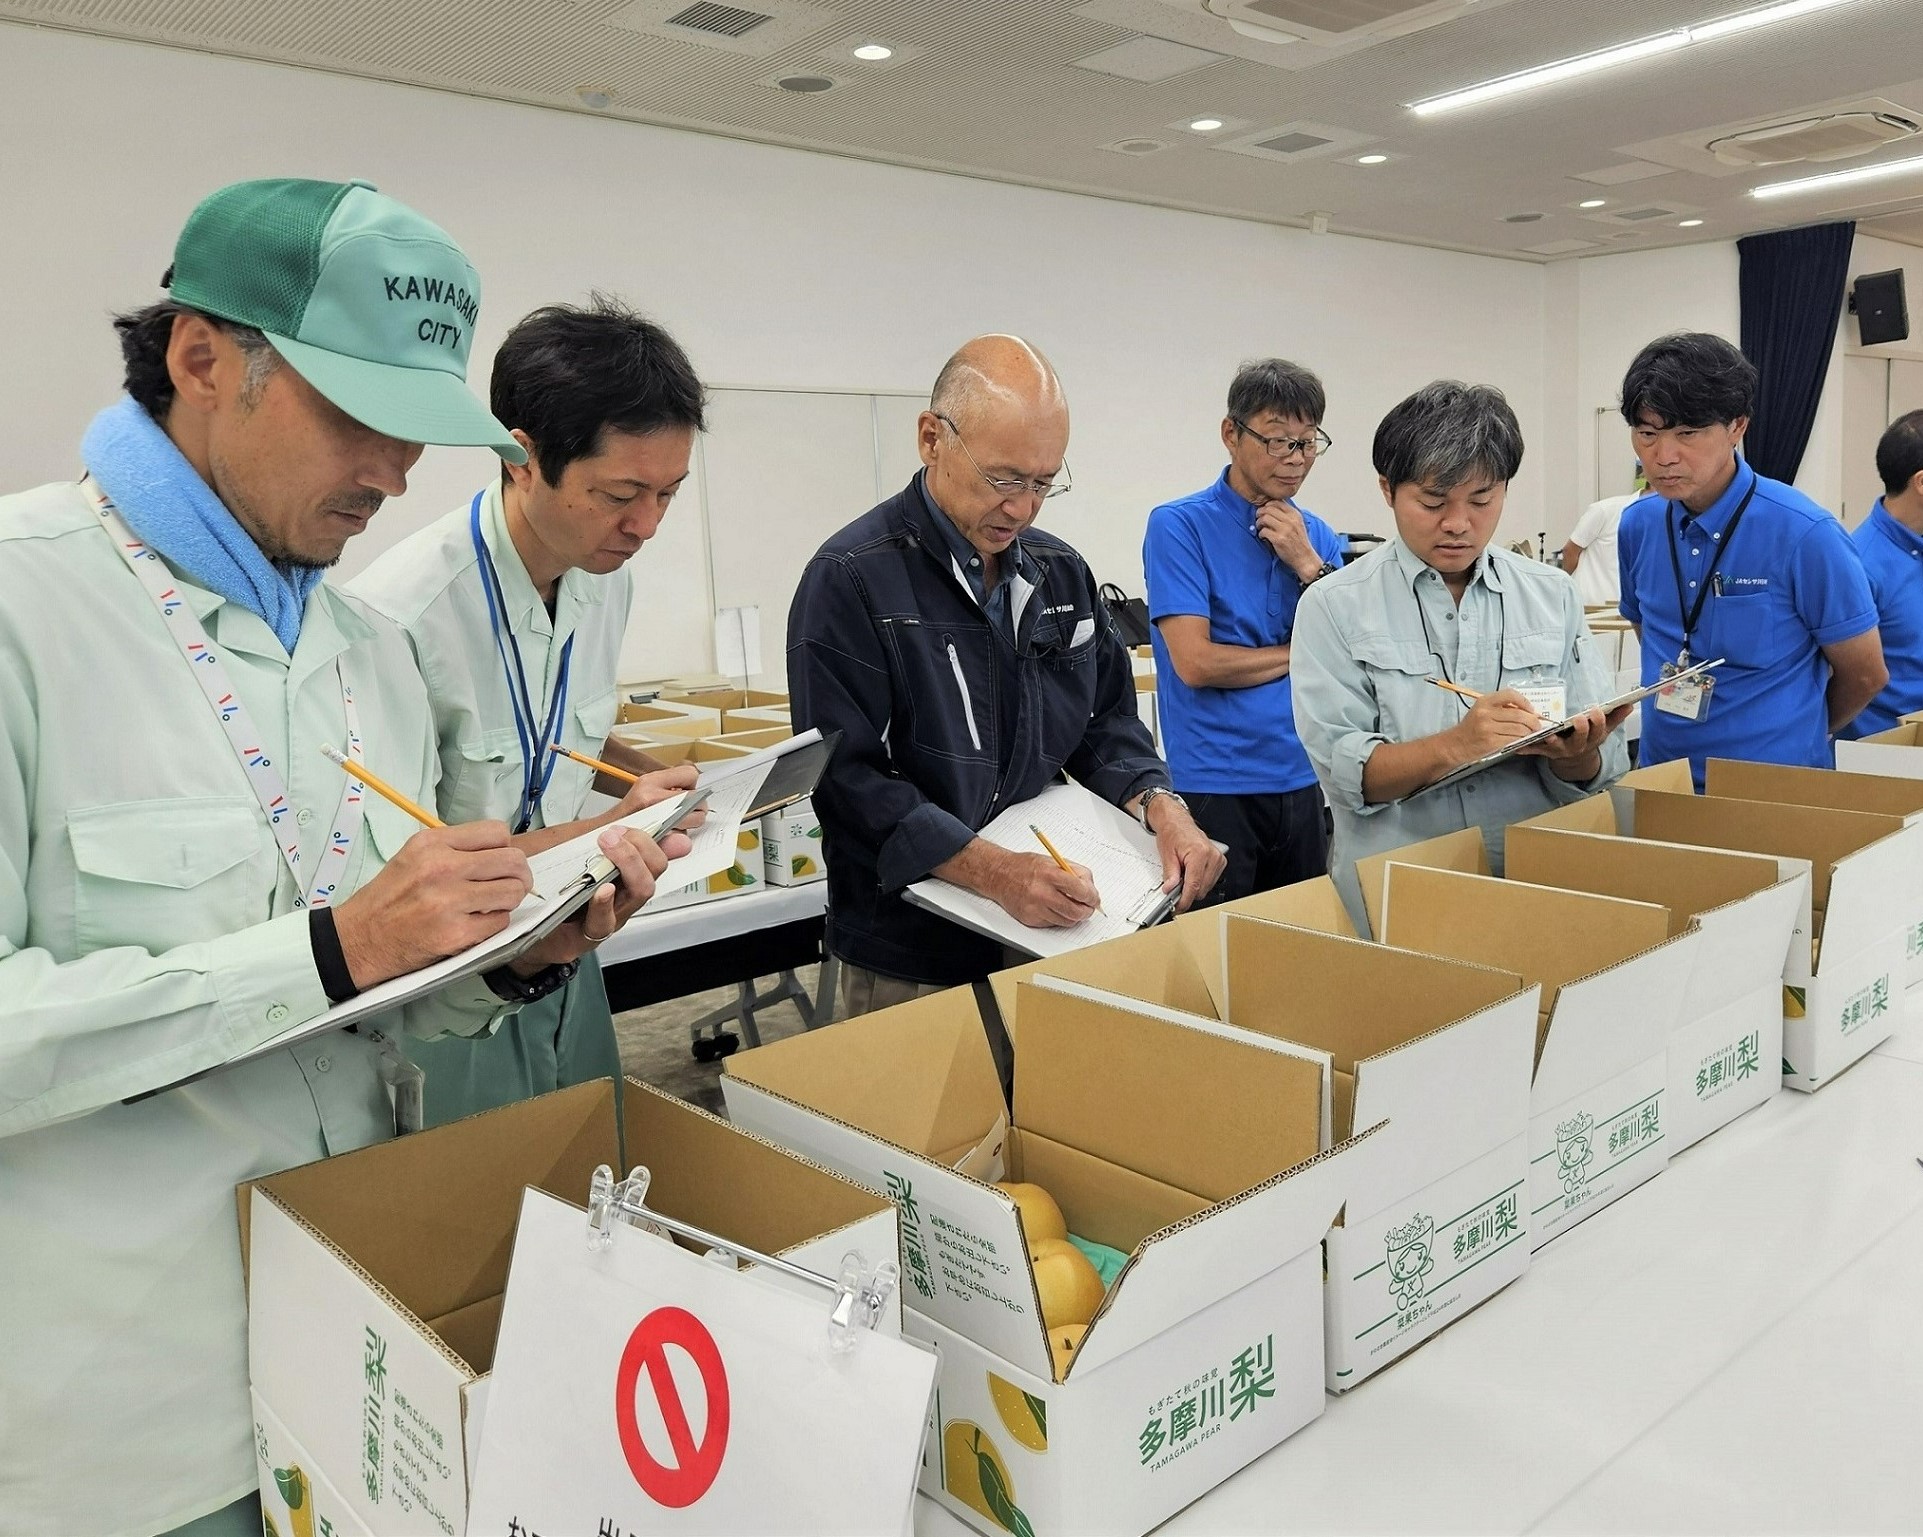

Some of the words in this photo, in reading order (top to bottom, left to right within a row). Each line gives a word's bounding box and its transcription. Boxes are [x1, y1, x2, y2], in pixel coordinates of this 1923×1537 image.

[383, 275, 479, 327] KAWASAKI
[418, 318, 461, 349] CITY
[1696, 1030, 1759, 1097] 多摩川梨
[1608, 1100, 1659, 1154] 多摩川梨
[1453, 1193, 1518, 1260] 多摩川梨
[365, 1324, 387, 1505] 多摩川梨
[1139, 1333, 1276, 1466] 多摩川梨
[1149, 1367, 1219, 1415] もぎたて秋の味覚
[1150, 1438, 1198, 1473] TAMAGAWA
[1201, 1423, 1221, 1442] PEAR
